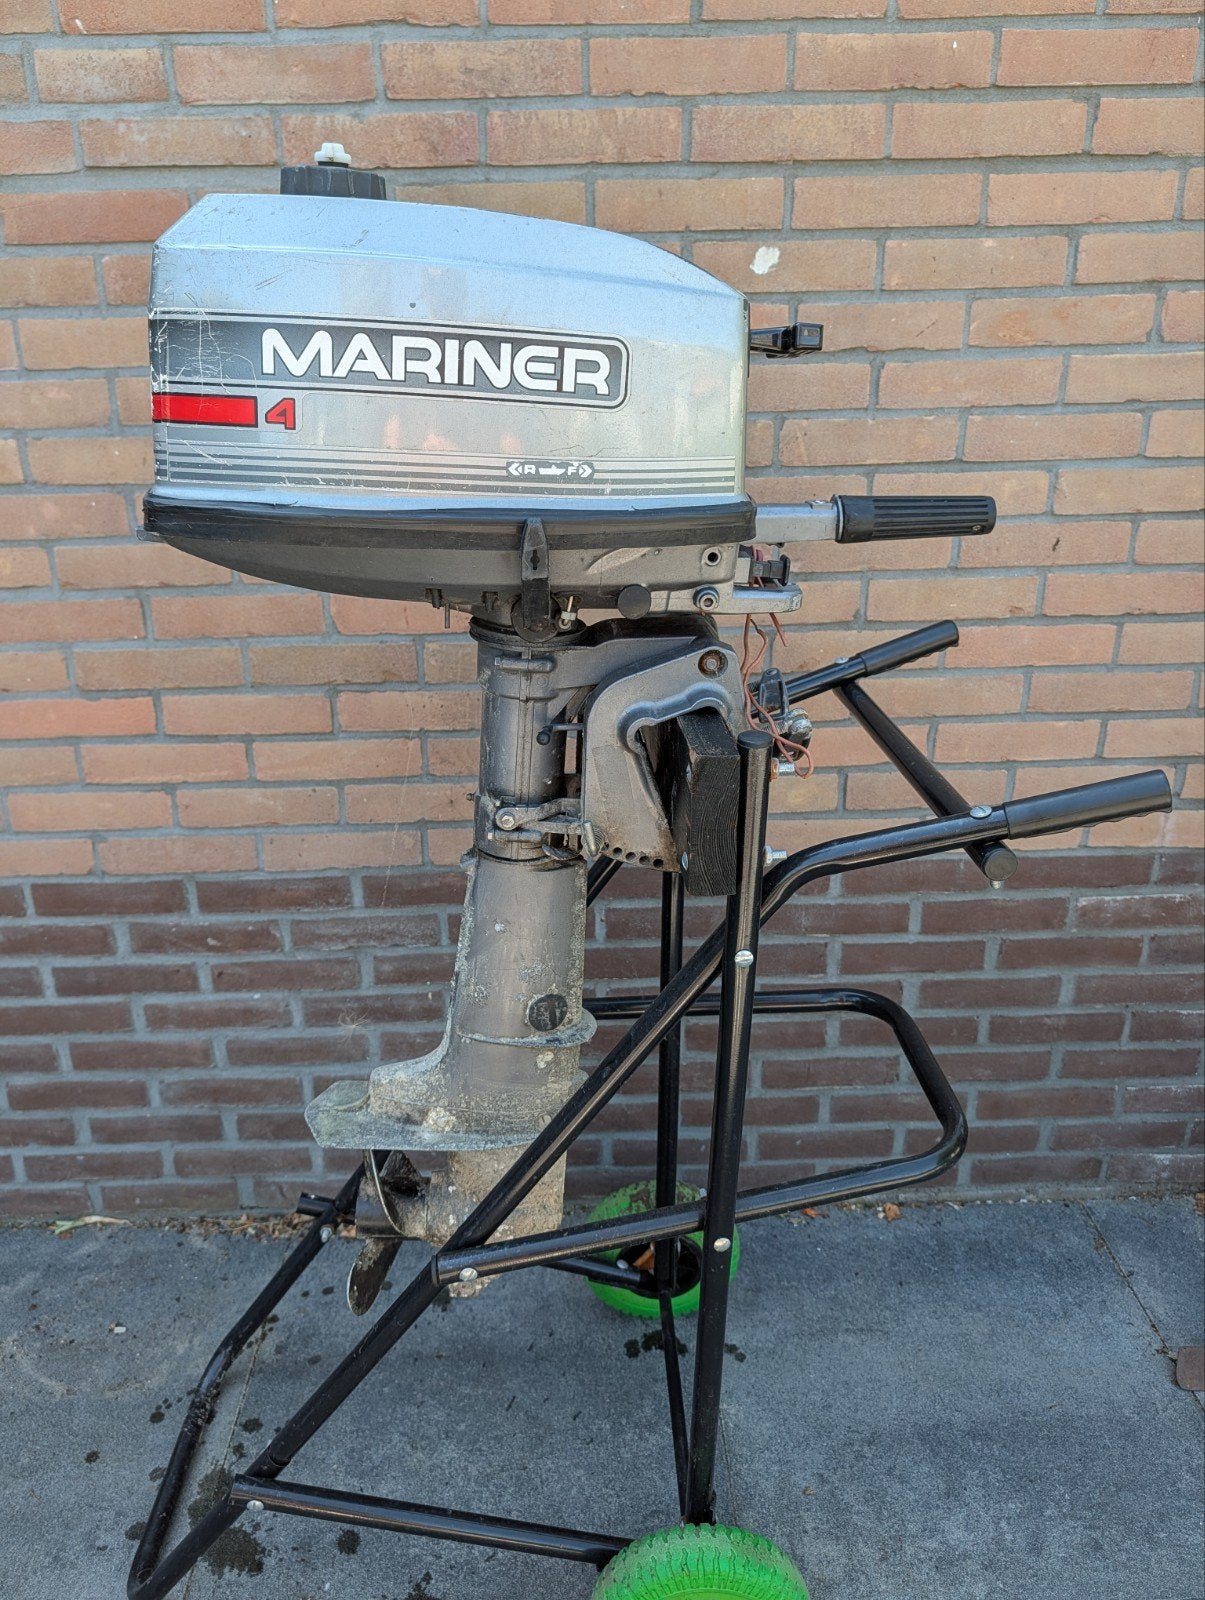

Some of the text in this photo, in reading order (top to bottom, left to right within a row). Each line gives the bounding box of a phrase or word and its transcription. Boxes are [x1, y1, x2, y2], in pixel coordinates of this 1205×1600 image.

[262, 328, 611, 396] MARINER
[265, 397, 296, 430] 4
[524, 464, 578, 476] R F
